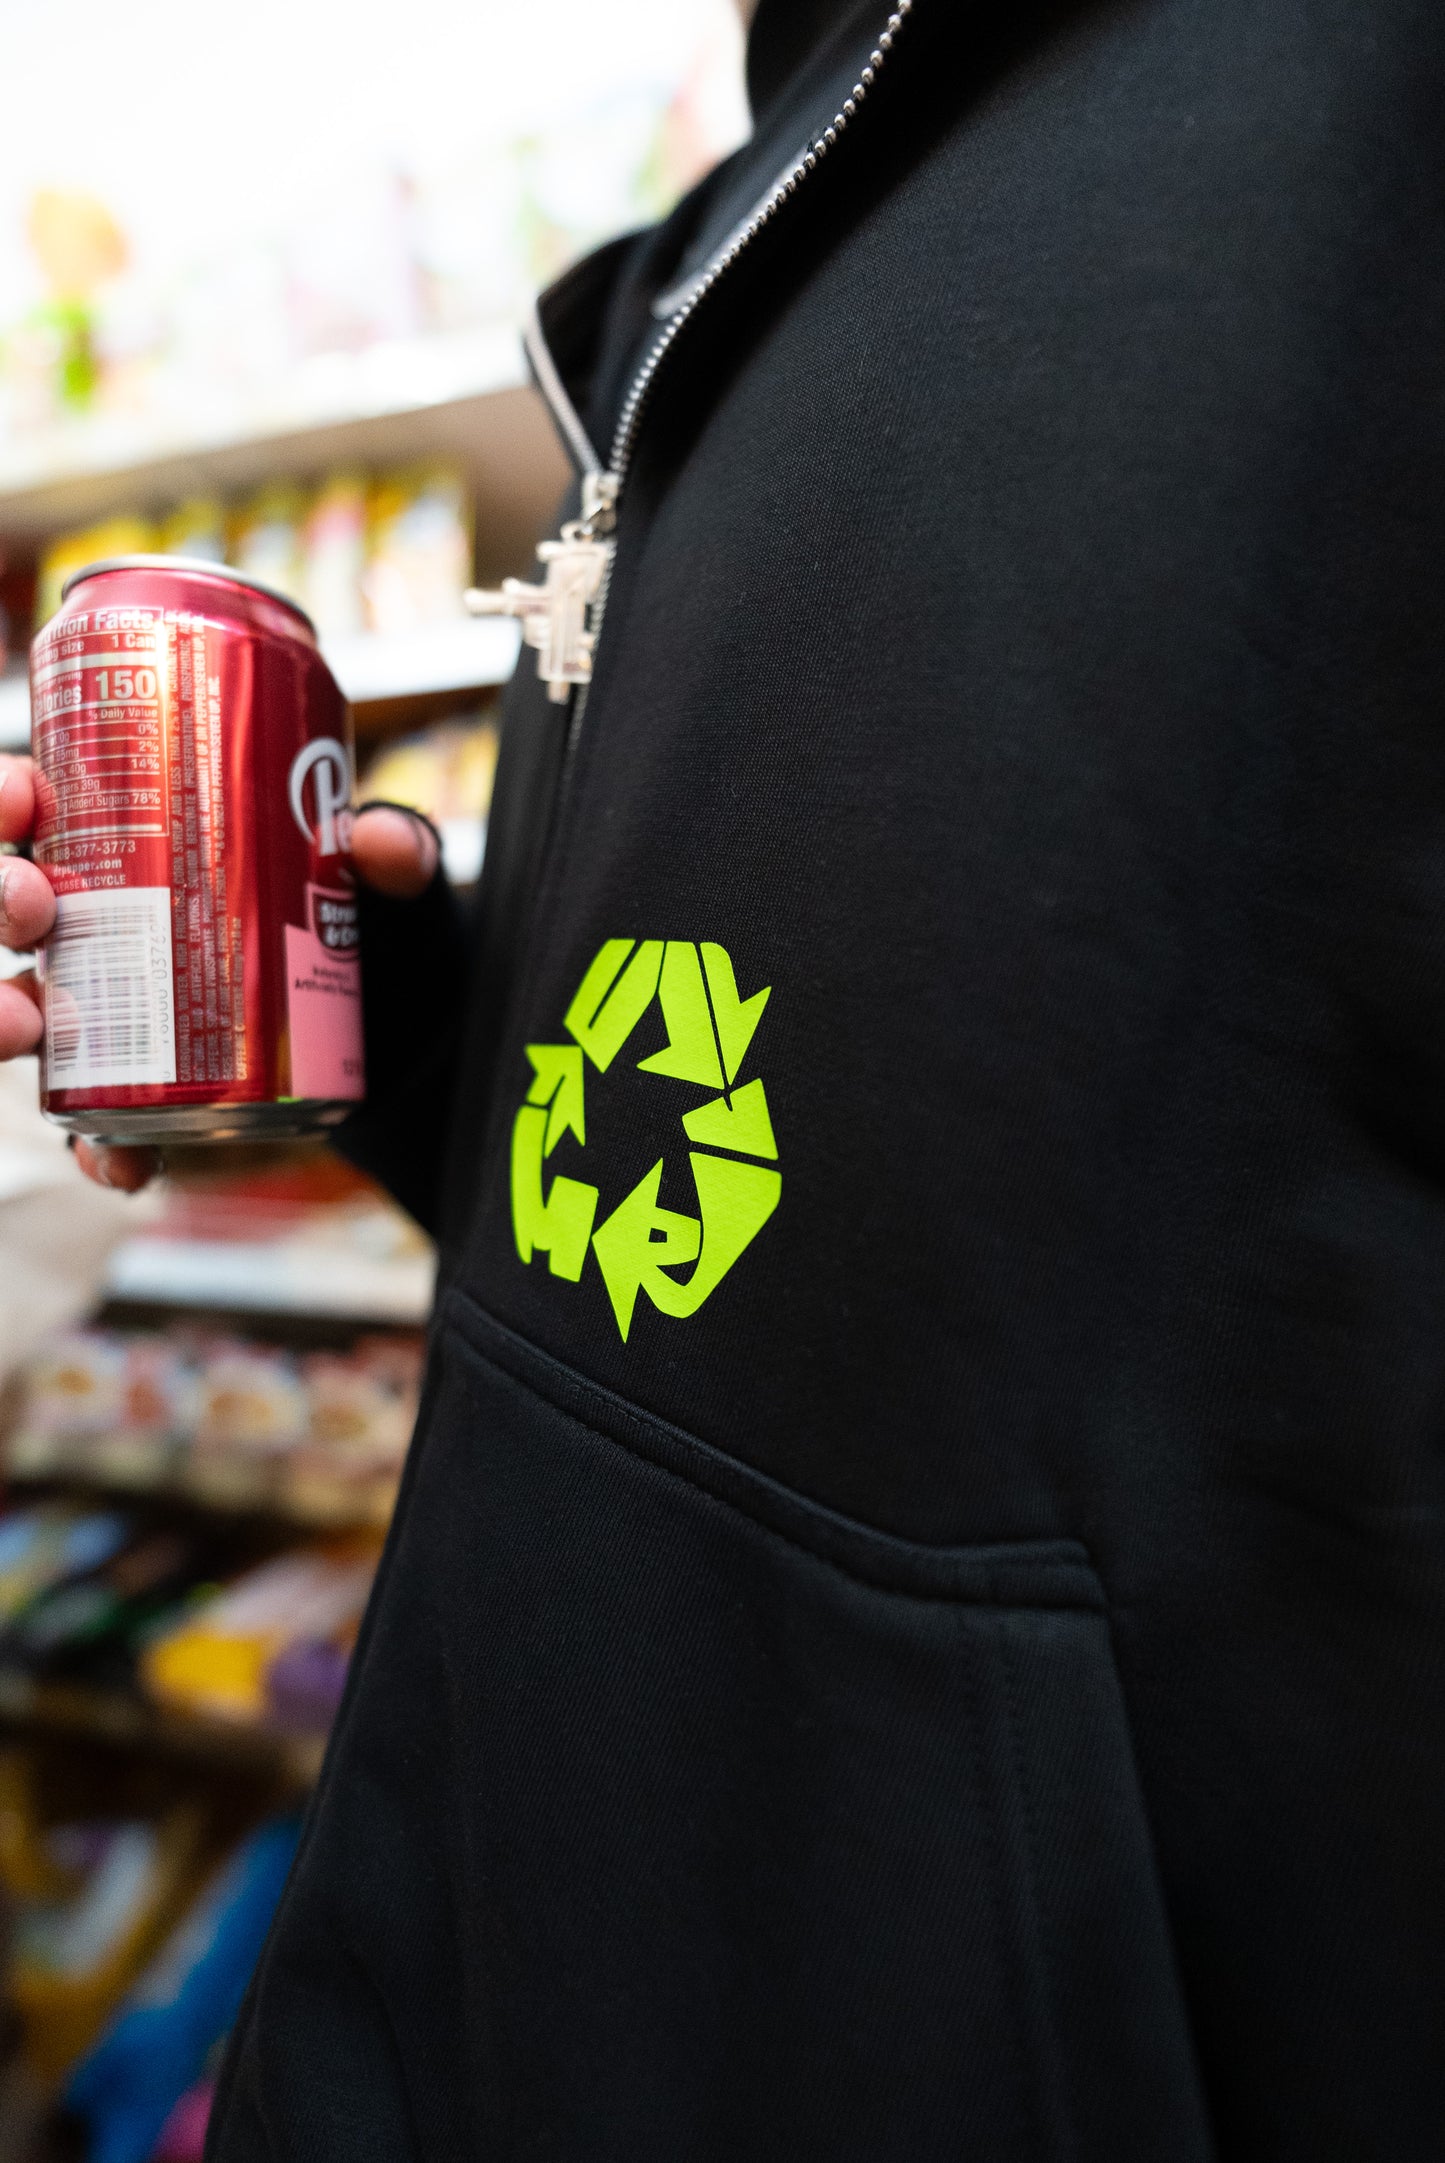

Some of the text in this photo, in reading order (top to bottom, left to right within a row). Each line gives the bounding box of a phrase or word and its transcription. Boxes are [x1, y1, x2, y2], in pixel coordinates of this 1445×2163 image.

[94, 609, 154, 630] Facts
[61, 640, 84, 656] size
[111, 632, 156, 648] 1 Can
[180, 640, 192, 701] PHOSPHORIC
[96, 669, 156, 700] 150
[100, 708, 126, 720] Daily
[128, 706, 158, 718] Value
[138, 723, 159, 736] 0%
[138, 740, 160, 753] 2%
[170, 736, 180, 761] THAN
[196, 742, 208, 756] OF
[130, 758, 160, 770] 14%
[82, 779, 100, 792] 39g
[171, 766, 182, 791] LESS
[196, 758, 210, 812] AUTHORITY
[96, 794, 130, 807] Sugars
[132, 792, 160, 805] 78%
[172, 794, 182, 816] AND
[185, 794, 198, 844] BENZOATE
[199, 814, 211, 832] THE
[172, 820, 184, 852] SYRUP
[81, 874, 126, 889] RECYCLE
[173, 857, 184, 884] CORN
[189, 894, 201, 942] FLAVORS,
[176, 944, 187, 968] HIGH
[190, 948, 202, 1002] ARTIFICIAL
[179, 1014, 191, 1082] CARBONATED
